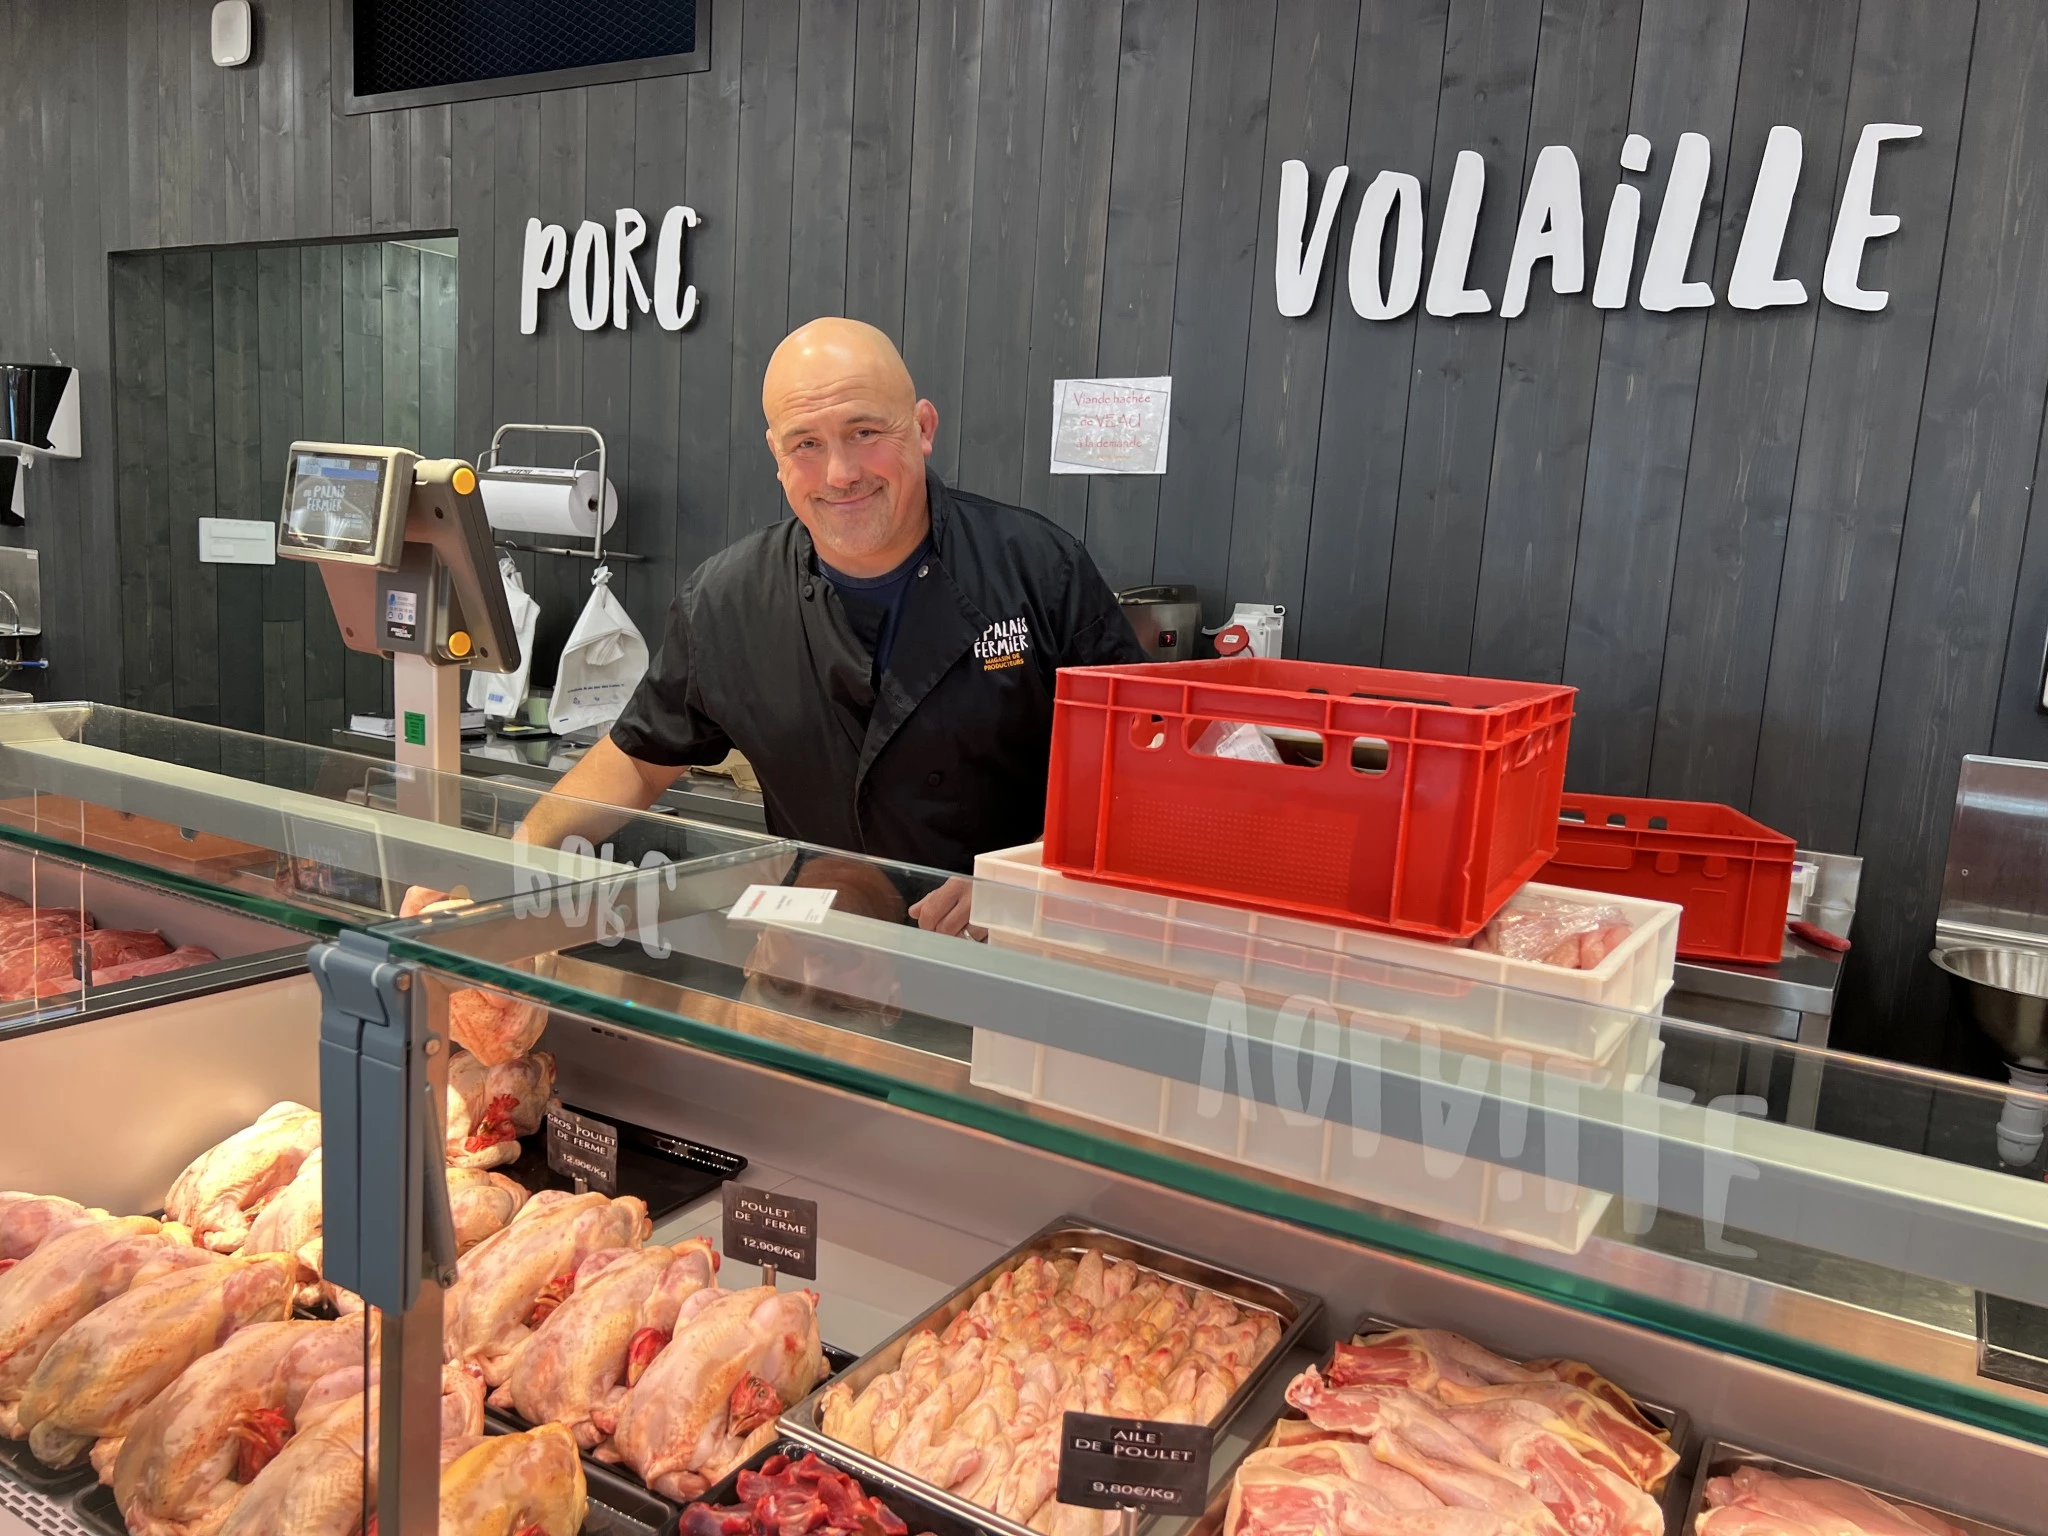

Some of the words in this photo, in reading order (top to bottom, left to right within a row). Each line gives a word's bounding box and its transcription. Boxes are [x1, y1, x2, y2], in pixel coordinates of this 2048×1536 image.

[520, 205, 697, 335] PORC
[1073, 391, 1110, 407] Viande
[1080, 413, 1094, 427] de
[1084, 435, 1094, 448] la
[1096, 434, 1143, 449] demande
[983, 657, 1025, 672] PRODUCTEURS
[985, 654, 1011, 665] MAGASIN
[1012, 652, 1021, 660] DE
[547, 1113, 572, 1131] GROS
[576, 1123, 617, 1146] POULET
[557, 1129, 569, 1141] DE
[573, 1137, 607, 1155] FERME
[741, 1199, 790, 1219] POULET
[735, 1210, 751, 1222] DE
[765, 1217, 808, 1235] FERME
[1113, 1430, 1157, 1444] AILE
[1075, 1438, 1102, 1452] DE
[1113, 1443, 1193, 1462] POULET
